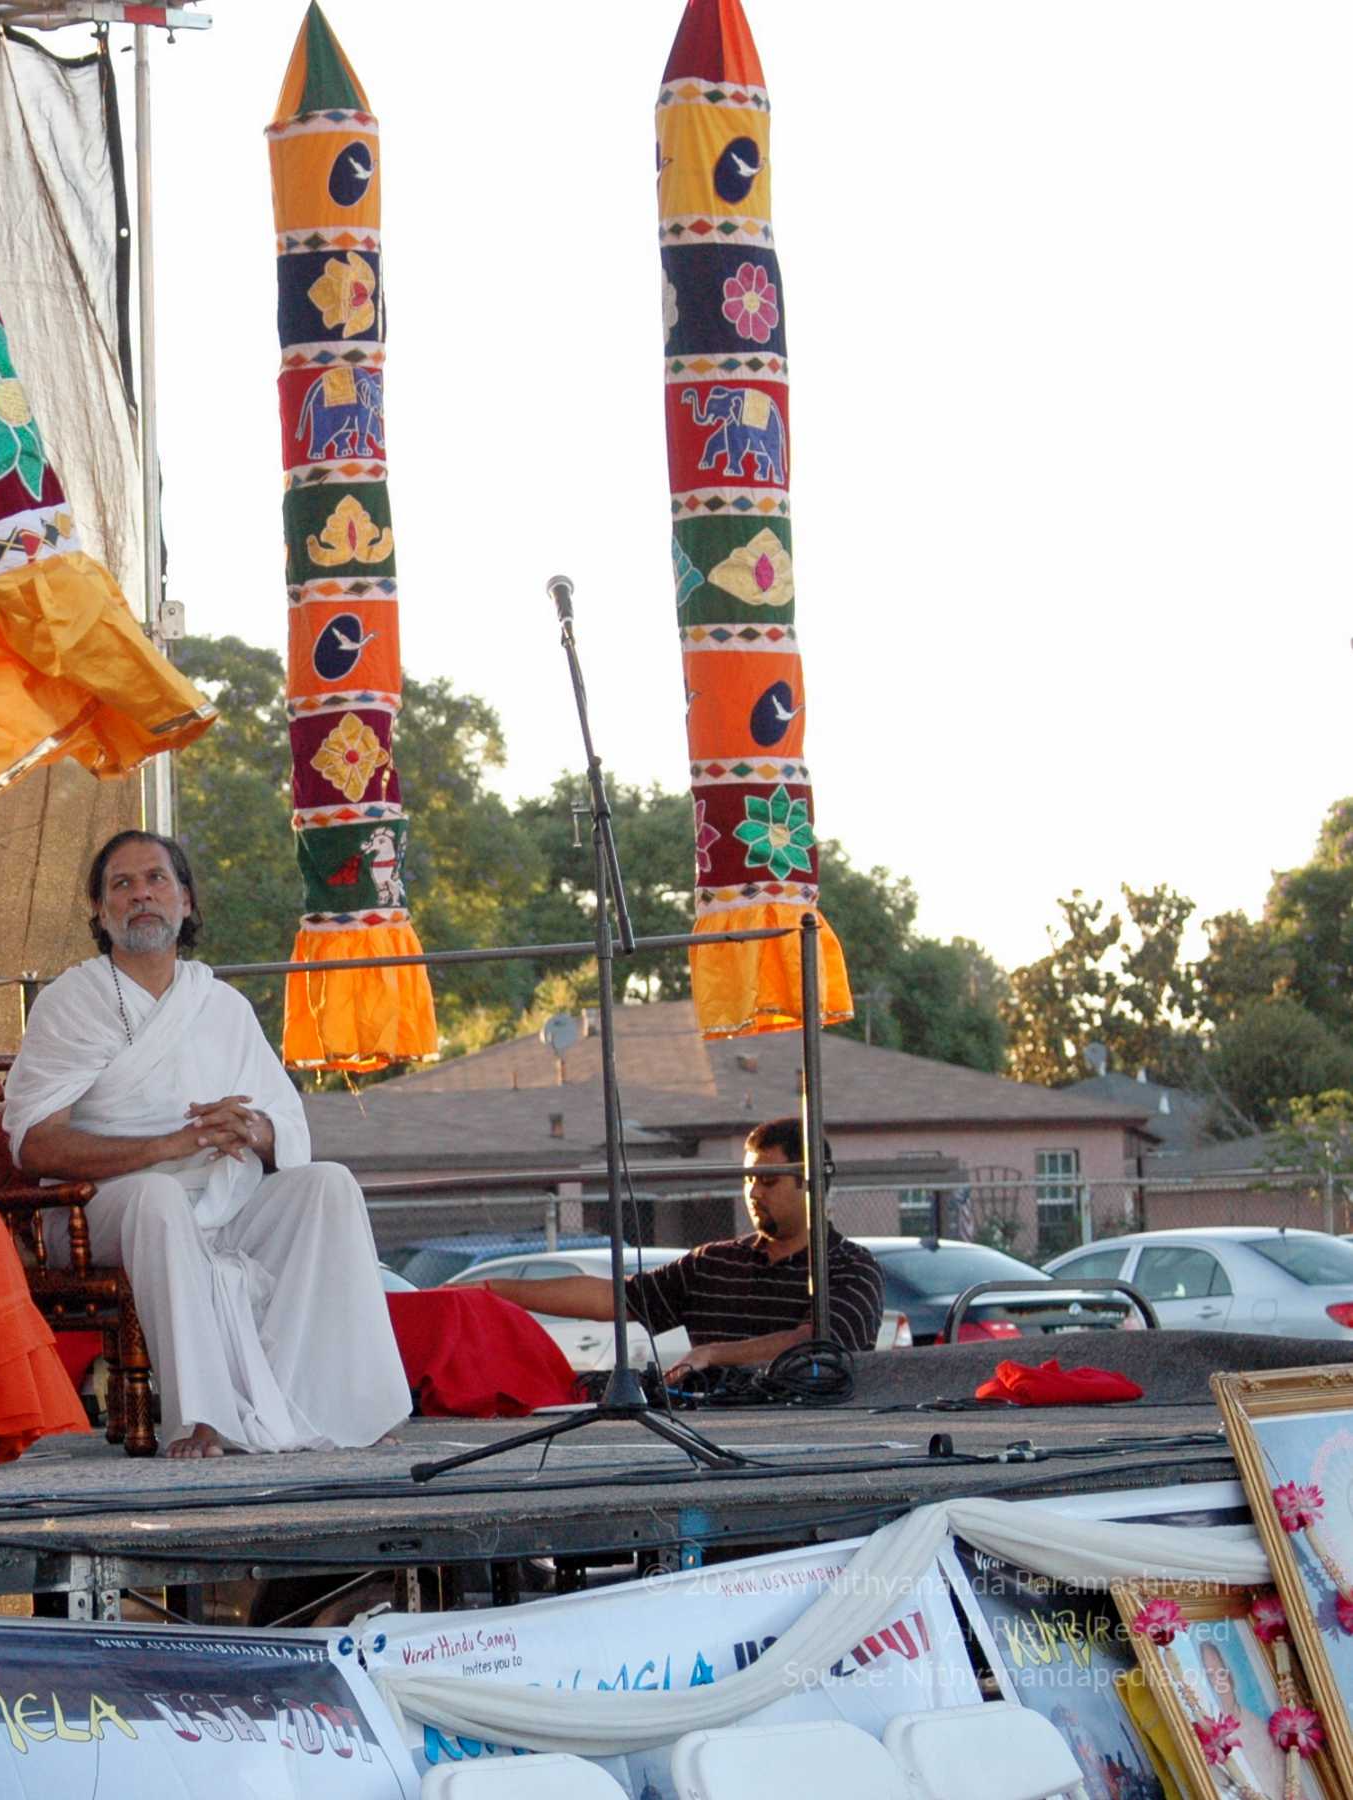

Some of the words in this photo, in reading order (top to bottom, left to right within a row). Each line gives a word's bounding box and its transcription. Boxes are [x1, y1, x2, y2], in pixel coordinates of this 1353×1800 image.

[401, 1640, 438, 1665] Virat
[437, 1632, 474, 1659] Hindu
[476, 1626, 517, 1652] Samaj
[462, 1660, 492, 1677] Invites
[493, 1659, 510, 1674] you
[512, 1655, 523, 1667] to
